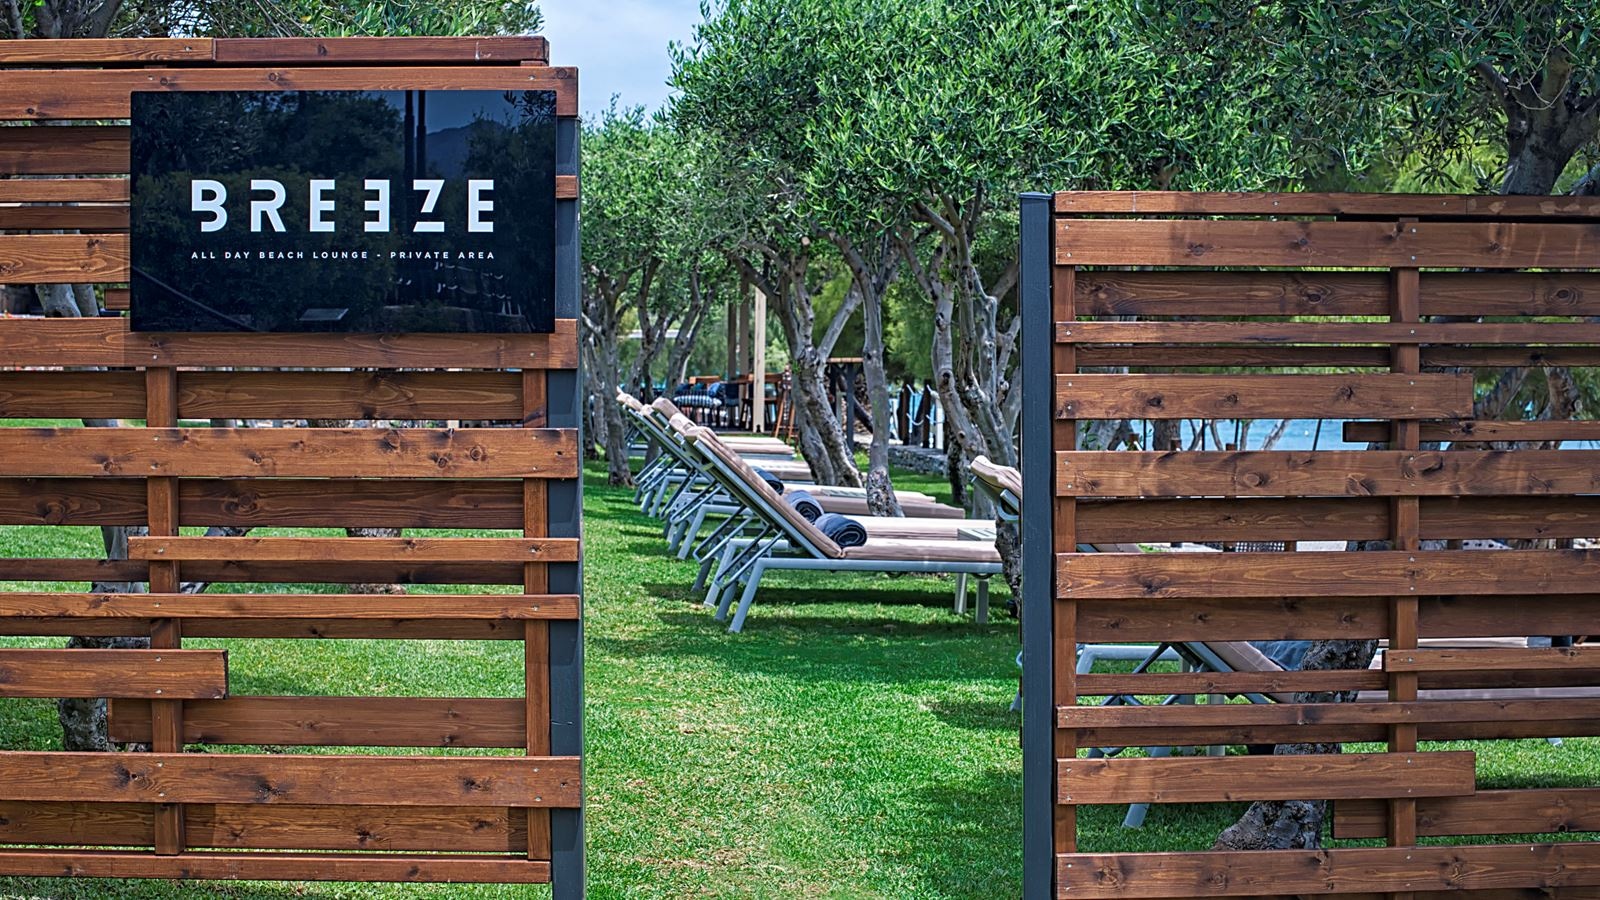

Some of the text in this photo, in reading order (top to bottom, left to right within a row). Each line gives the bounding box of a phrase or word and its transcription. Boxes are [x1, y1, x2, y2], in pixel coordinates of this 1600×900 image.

[191, 179, 495, 233] BREEZE
[191, 251, 216, 259] ALL
[225, 251, 251, 259] DAY
[259, 251, 304, 259] BEACH
[312, 251, 368, 259] LOUNGE
[390, 251, 450, 259] PRIVATE
[458, 251, 495, 259] AREA
